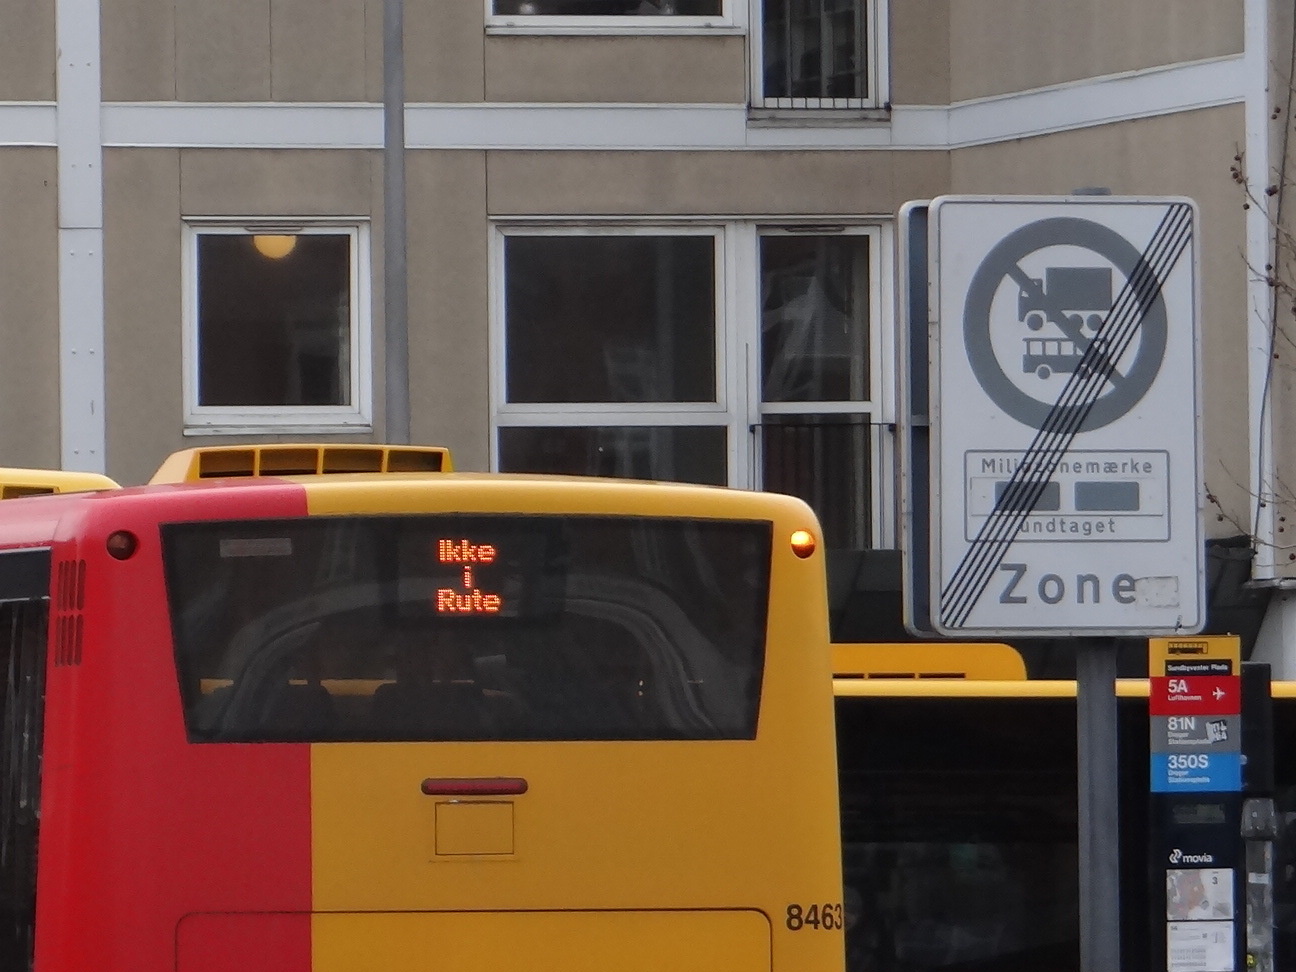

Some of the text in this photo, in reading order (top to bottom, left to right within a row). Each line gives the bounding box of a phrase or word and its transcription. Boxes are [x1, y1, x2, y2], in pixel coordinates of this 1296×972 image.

[1020, 517, 1116, 536] undtaget
[439, 539, 496, 562] Ikke
[464, 565, 471, 587] i
[999, 563, 1137, 605] Zone
[438, 588, 501, 612] Rute
[1168, 679, 1188, 693] 5A
[1168, 717, 1195, 731] 81N
[1168, 755, 1209, 769] 350S
[1182, 853, 1213, 863] movia
[786, 903, 843, 931] 8463
